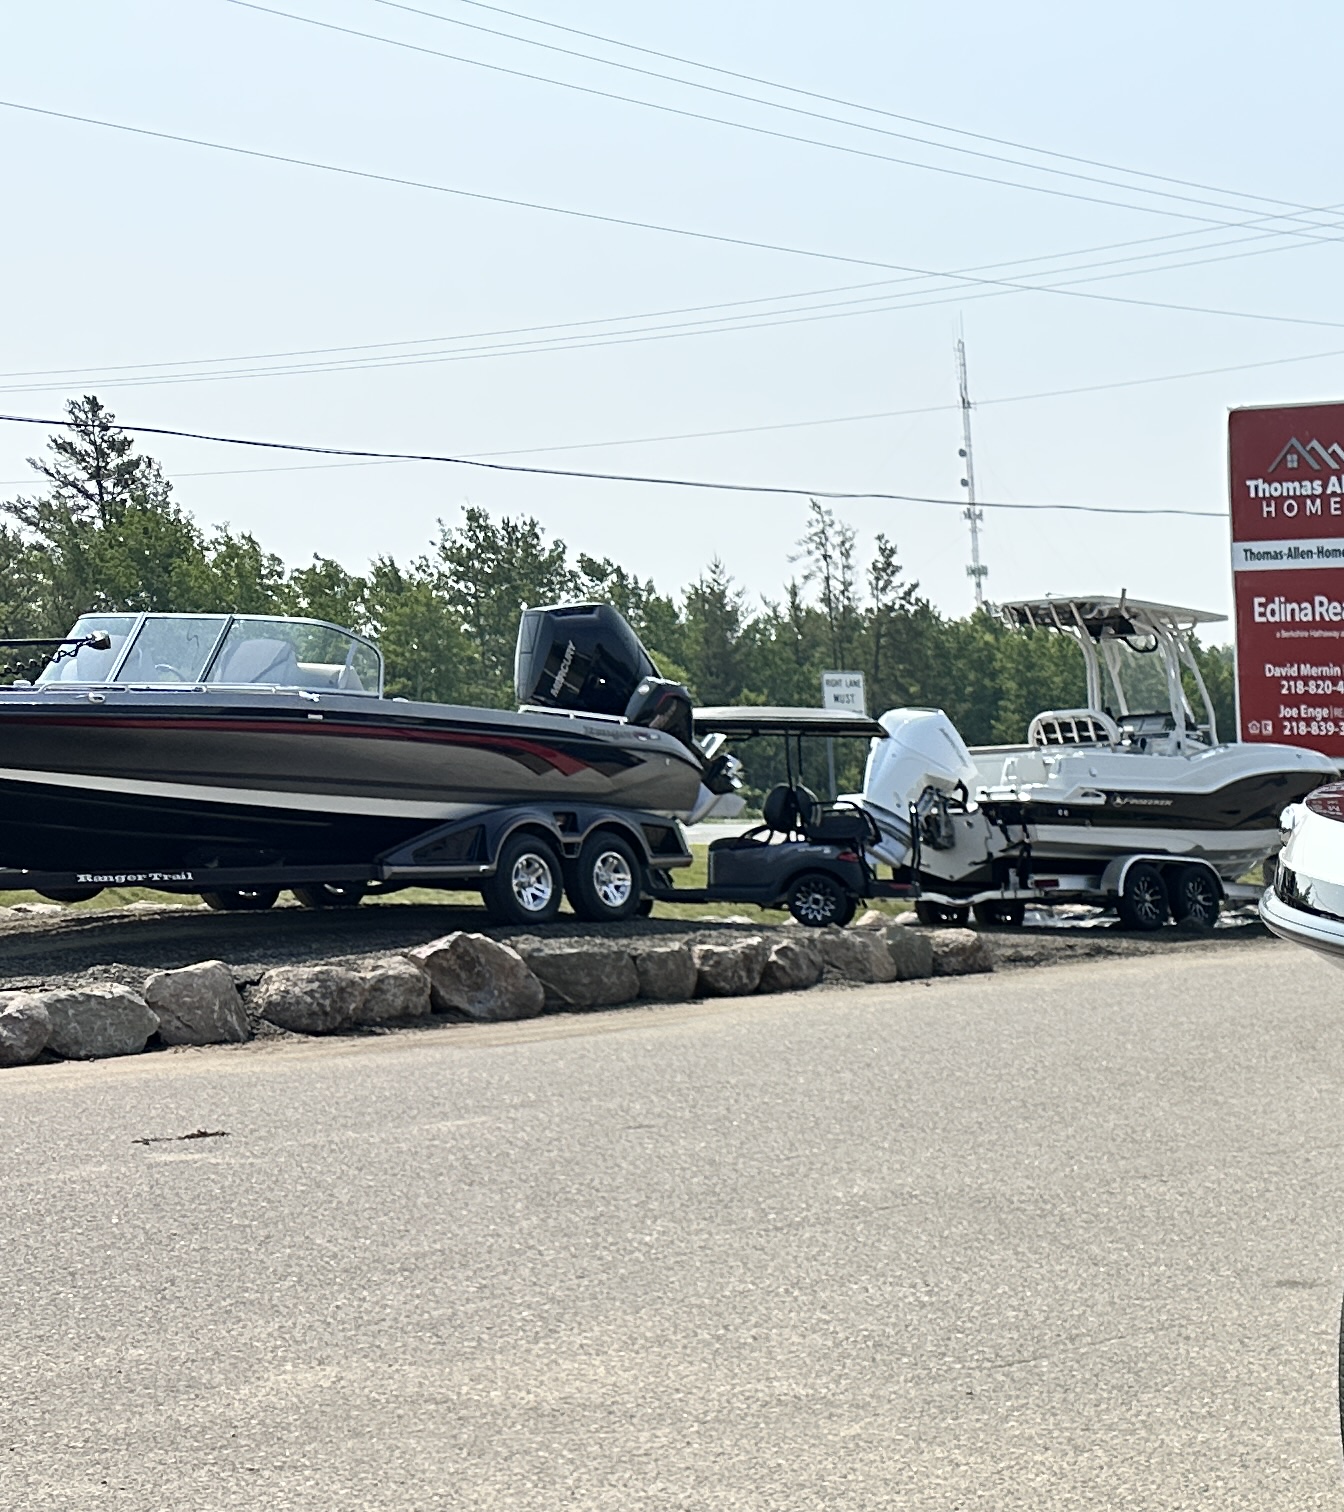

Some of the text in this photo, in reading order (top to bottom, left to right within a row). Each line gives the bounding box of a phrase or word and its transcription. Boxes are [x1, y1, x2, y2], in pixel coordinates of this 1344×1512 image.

[1246, 478, 1323, 498] Thomas
[550, 640, 576, 697] MERCURY
[1265, 663, 1298, 677] David
[1300, 663, 1341, 677] Mernin
[1278, 705, 1299, 718] Joe
[1300, 705, 1329, 721] Enge
[76, 871, 194, 883] Ranger Trail
